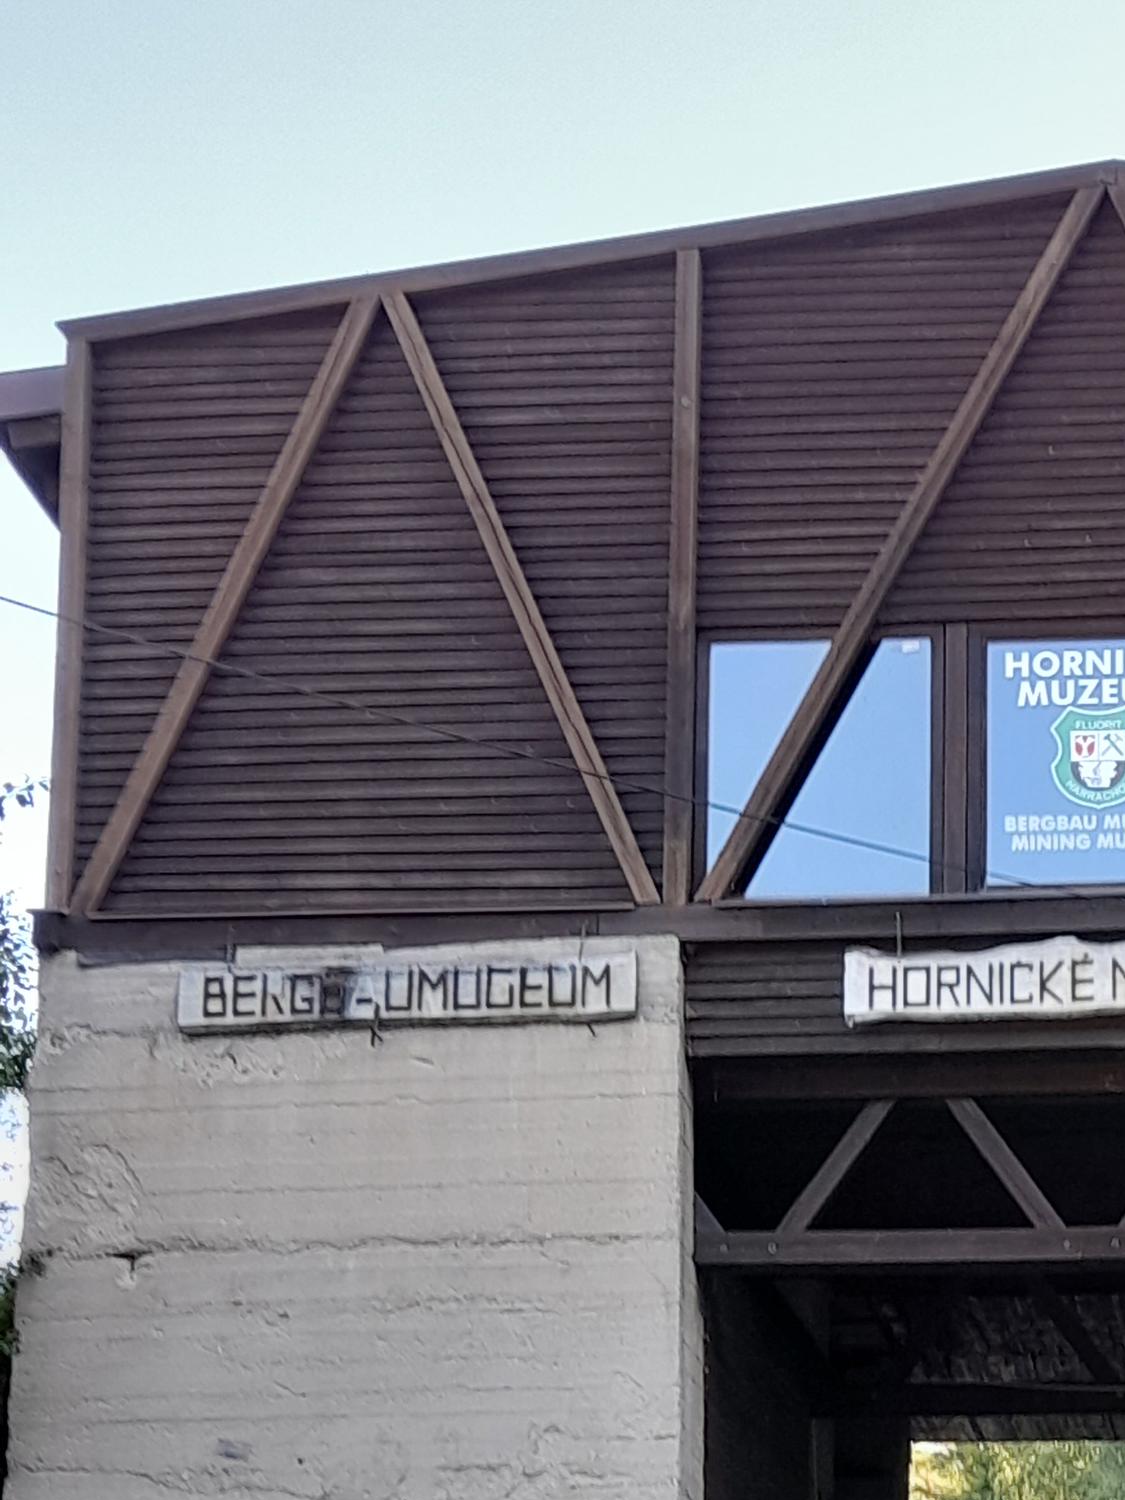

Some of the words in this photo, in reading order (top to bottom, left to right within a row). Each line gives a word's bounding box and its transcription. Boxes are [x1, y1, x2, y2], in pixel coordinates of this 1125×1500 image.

[1075, 719, 1122, 730] FLUORIT
[1004, 814, 1097, 833] BERGBAU
[1011, 833, 1091, 852] MINING
[868, 951, 1095, 1011] HORNICKÉ
